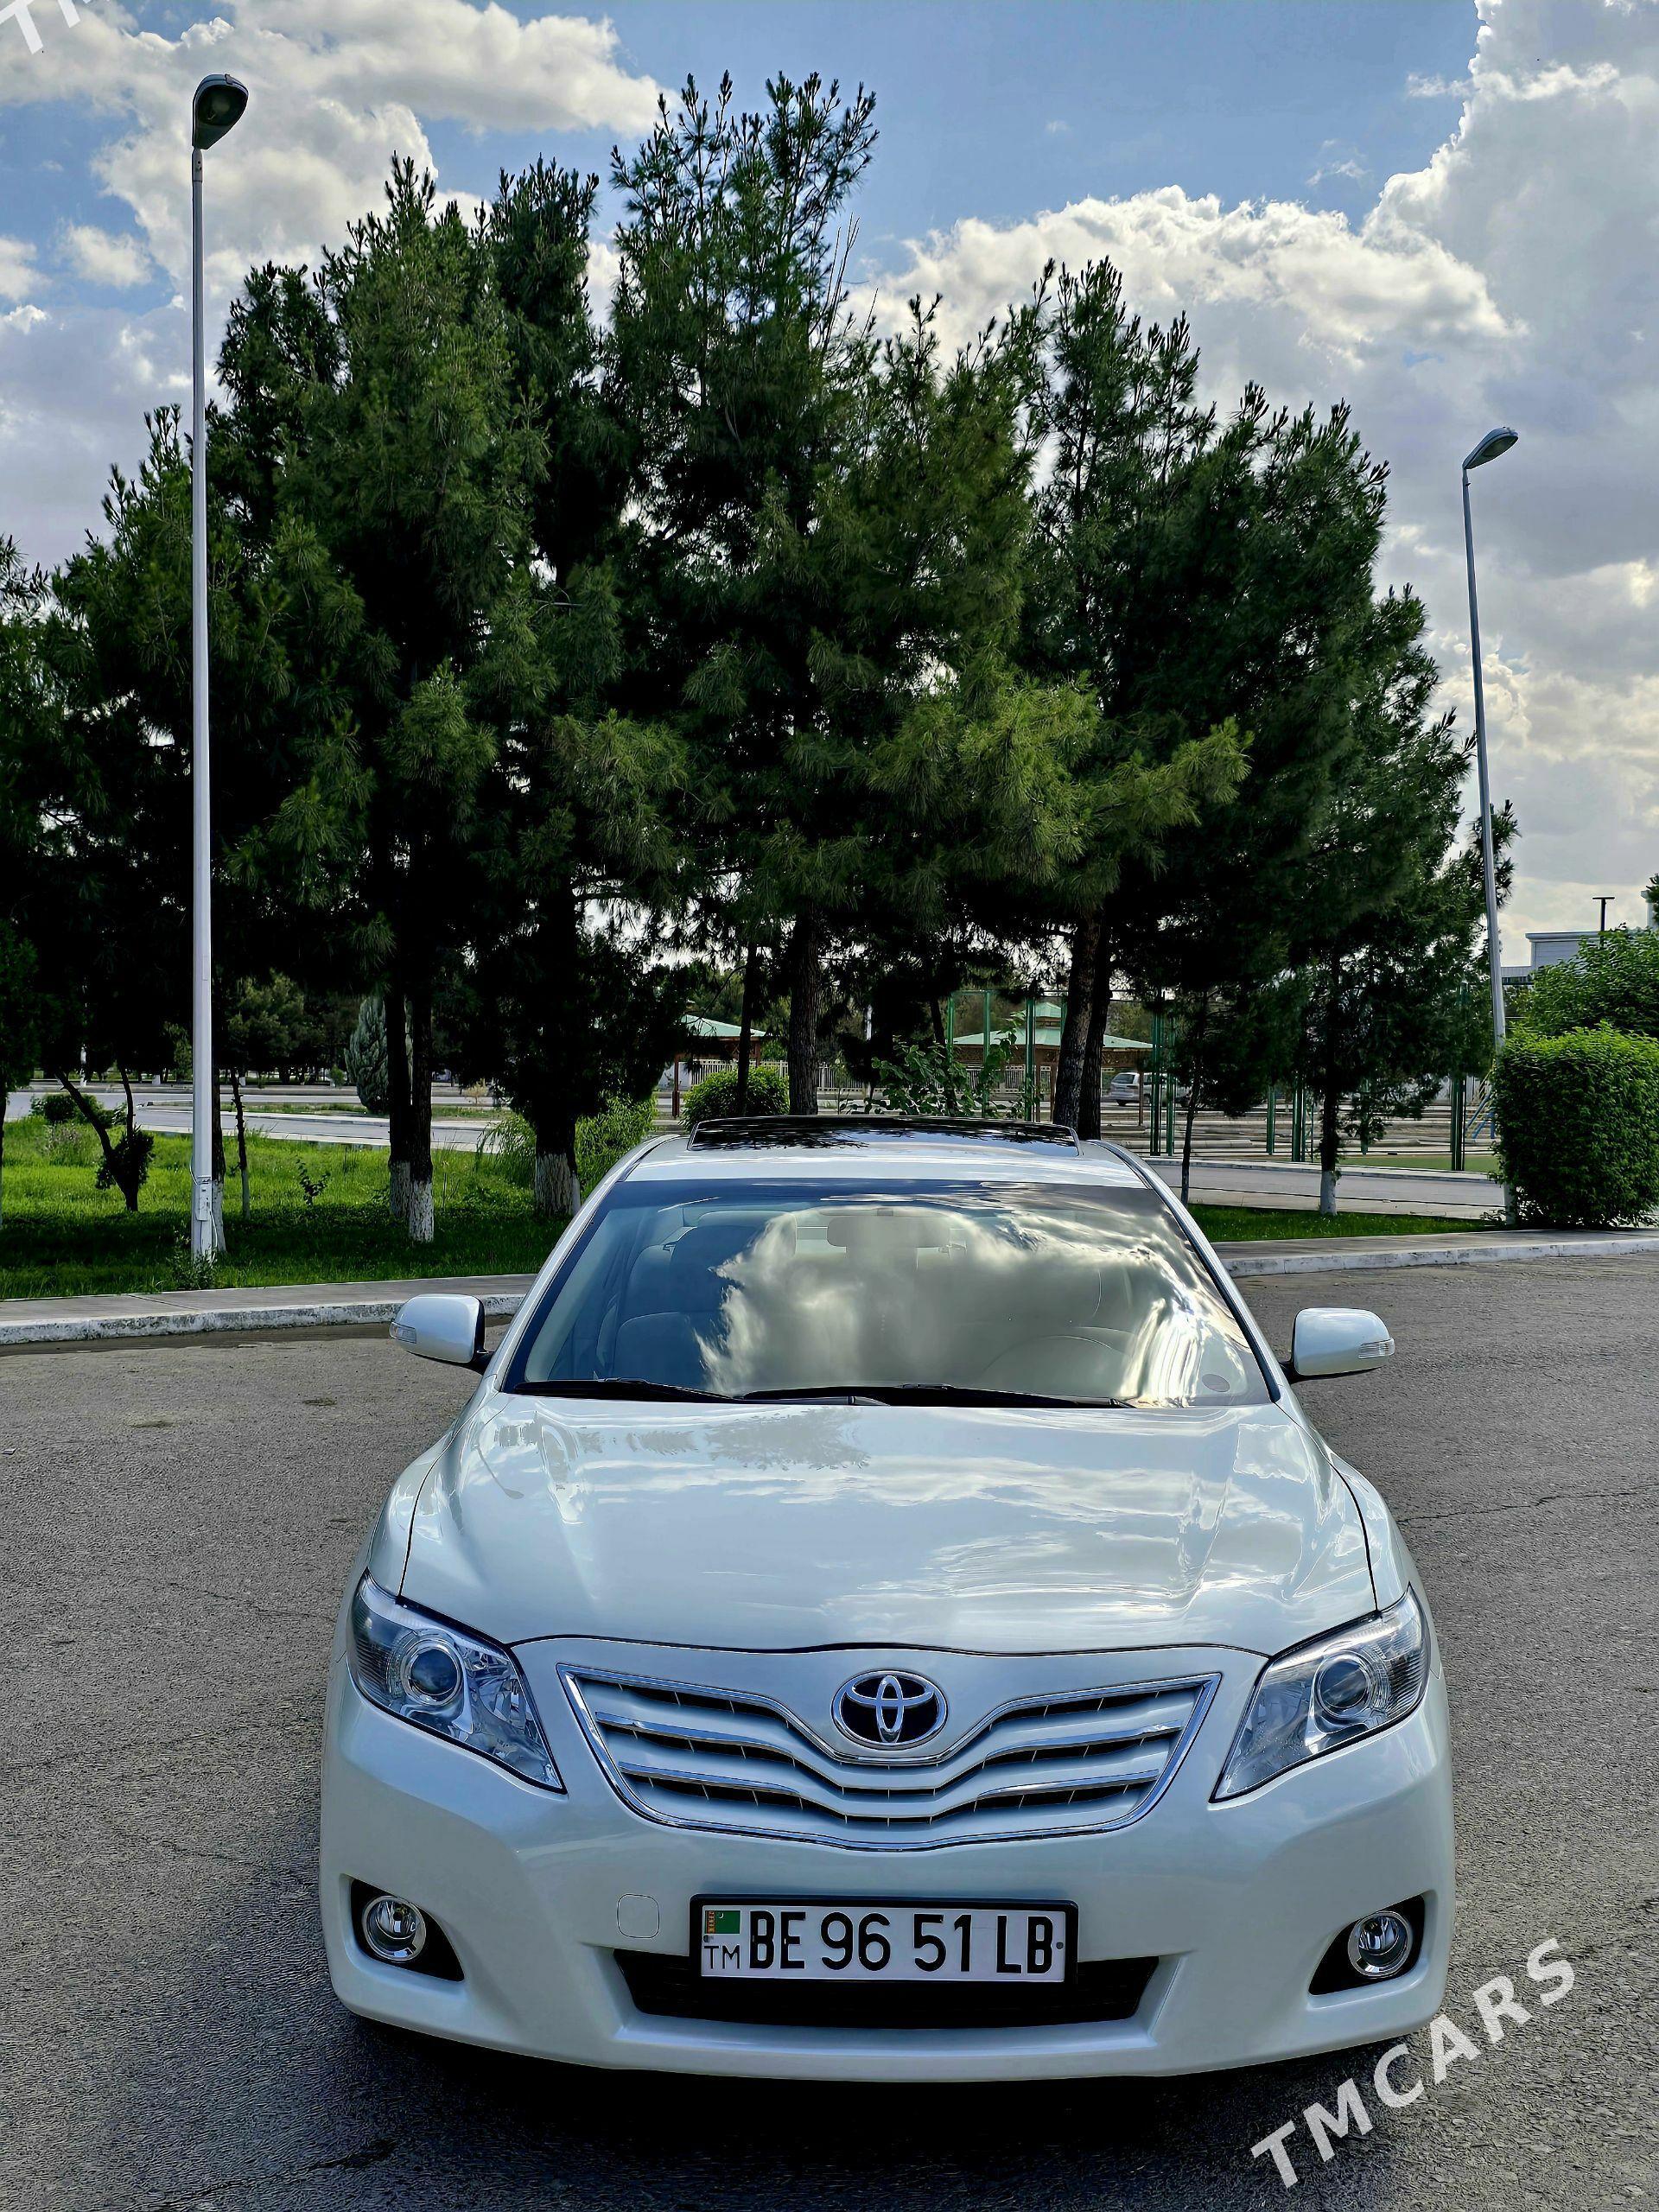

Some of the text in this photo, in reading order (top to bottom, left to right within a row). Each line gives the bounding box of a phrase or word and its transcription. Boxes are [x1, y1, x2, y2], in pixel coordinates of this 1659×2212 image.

[703, 1945, 741, 1969] TM
[750, 1910, 1053, 1974] BE 96 51 LB
